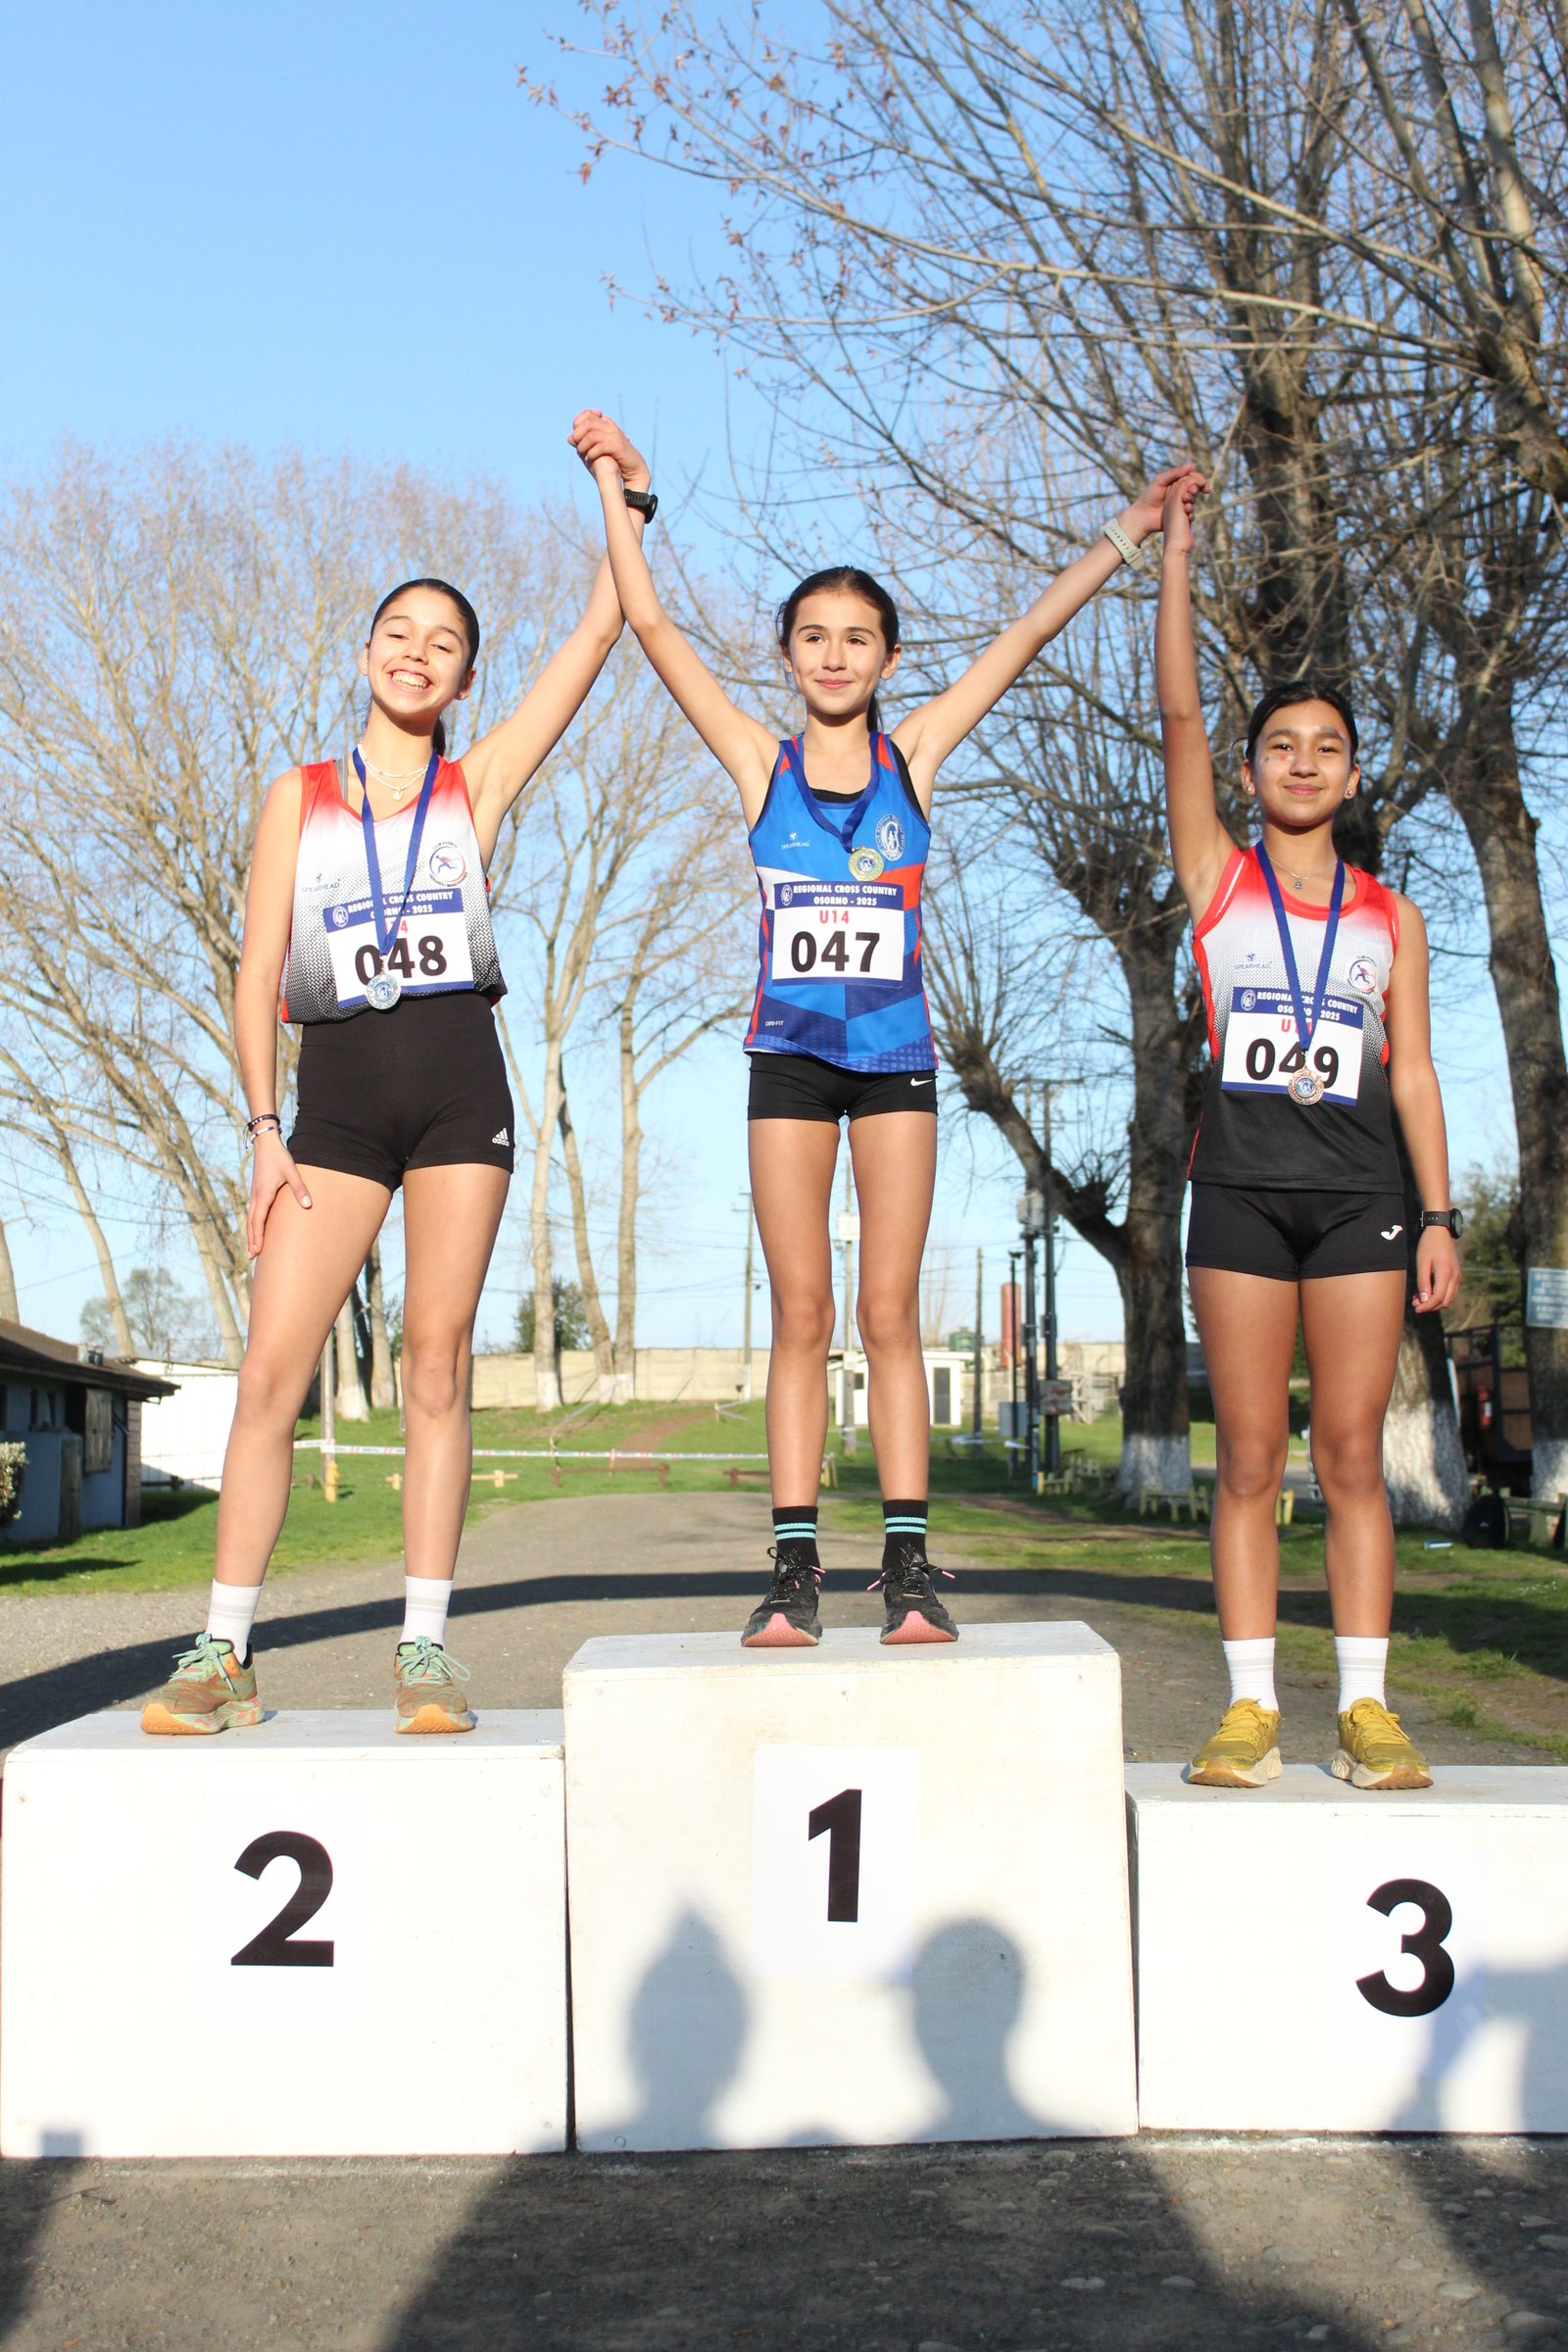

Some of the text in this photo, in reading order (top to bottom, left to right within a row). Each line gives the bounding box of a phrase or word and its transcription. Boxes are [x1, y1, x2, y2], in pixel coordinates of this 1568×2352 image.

[347, 897, 387, 913] REGIOL
[416, 892, 454, 902] COUNTRY
[862, 885, 897, 896] COUNTRY
[413, 905, 433, 914] 2025
[819, 909, 850, 923] U14
[355, 935, 447, 986] 048
[791, 931, 880, 972] 047
[1256, 992, 1293, 1003] REGIONA
[1327, 1000, 1358, 1013] COUNTRY
[1277, 1004, 1341, 1021] OSOO 2025
[1246, 1038, 1339, 1089] 049
[808, 1788, 862, 1923] 1
[230, 1830, 334, 1967] 2
[1355, 1879, 1455, 2018] 3
